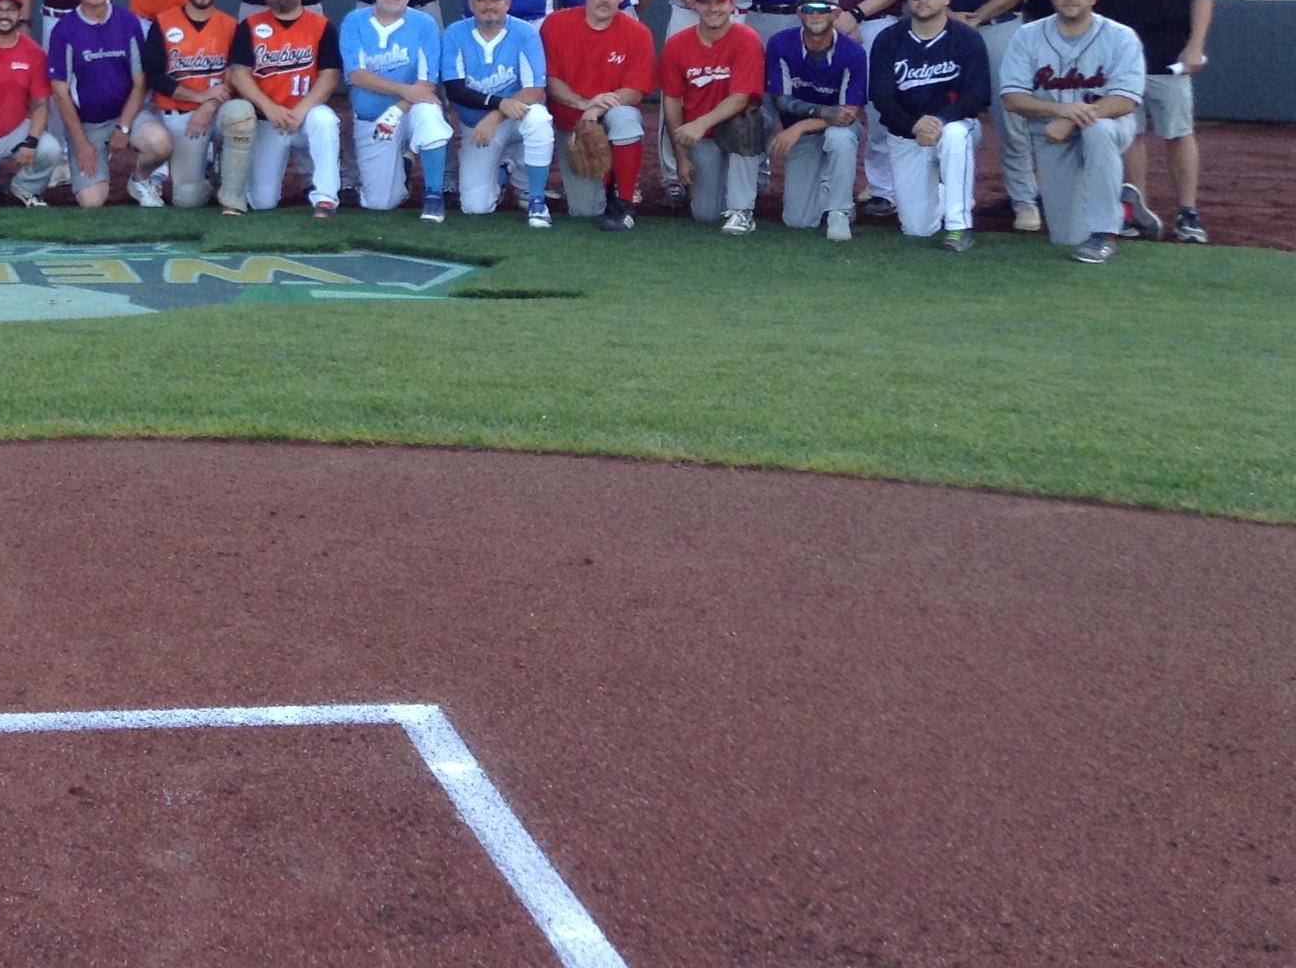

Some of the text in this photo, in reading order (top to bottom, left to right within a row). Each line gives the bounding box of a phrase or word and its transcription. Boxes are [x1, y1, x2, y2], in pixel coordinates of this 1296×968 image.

[254, 42, 314, 72] Cowboys
[291, 74, 311, 96] 11
[894, 58, 961, 90] Dodgers
